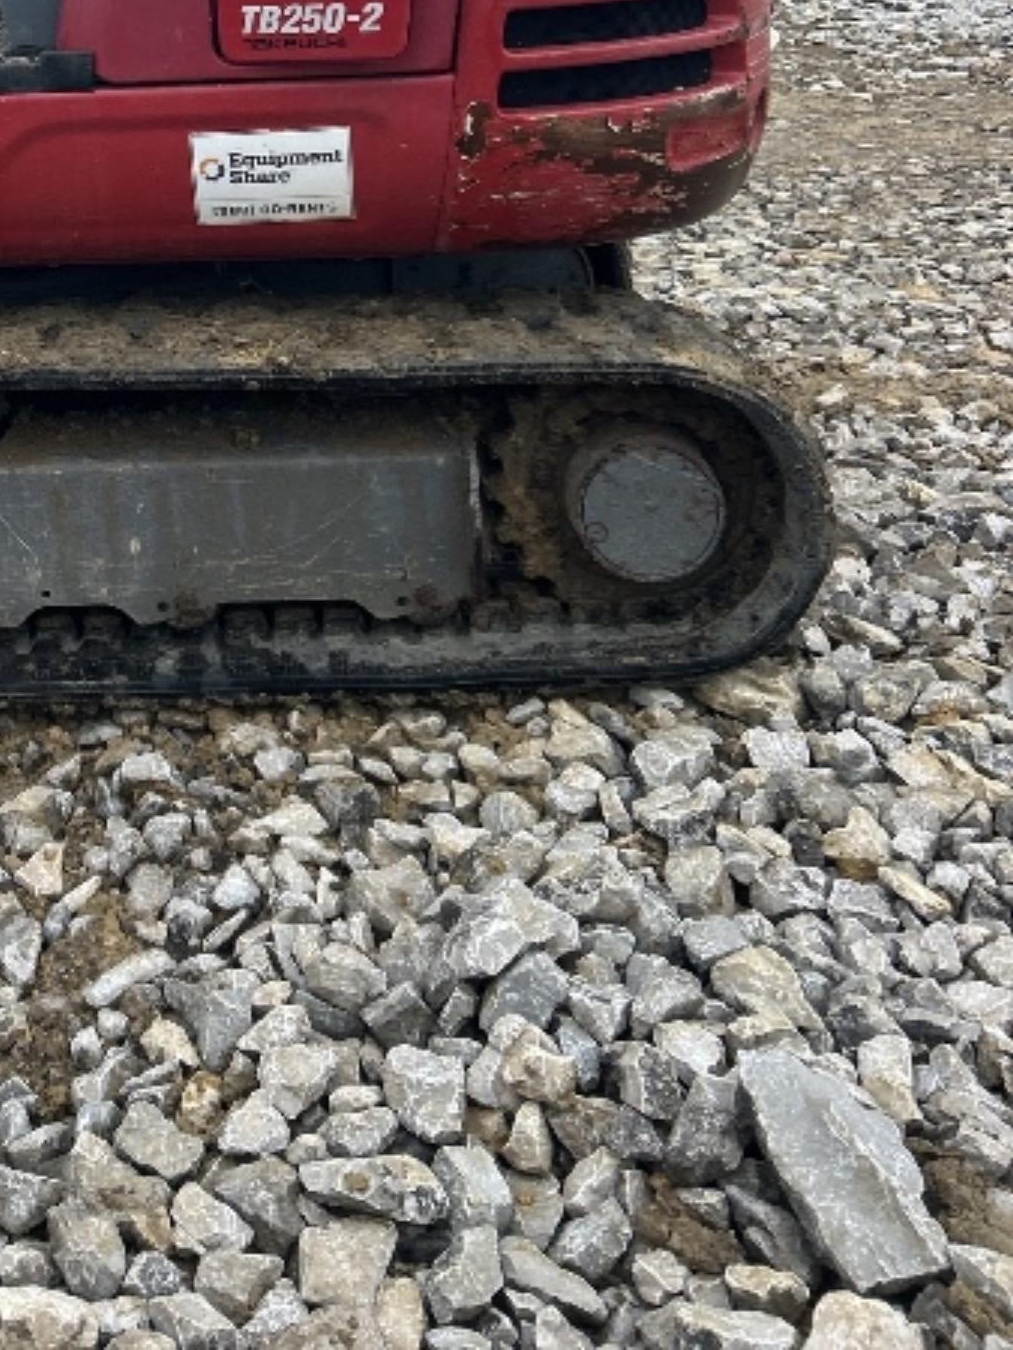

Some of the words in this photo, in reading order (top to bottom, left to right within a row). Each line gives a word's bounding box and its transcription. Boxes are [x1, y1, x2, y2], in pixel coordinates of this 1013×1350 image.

[241, 2, 384, 35] TB250-2
[228, 149, 343, 170] Equipment
[229, 170, 290, 185] Share
